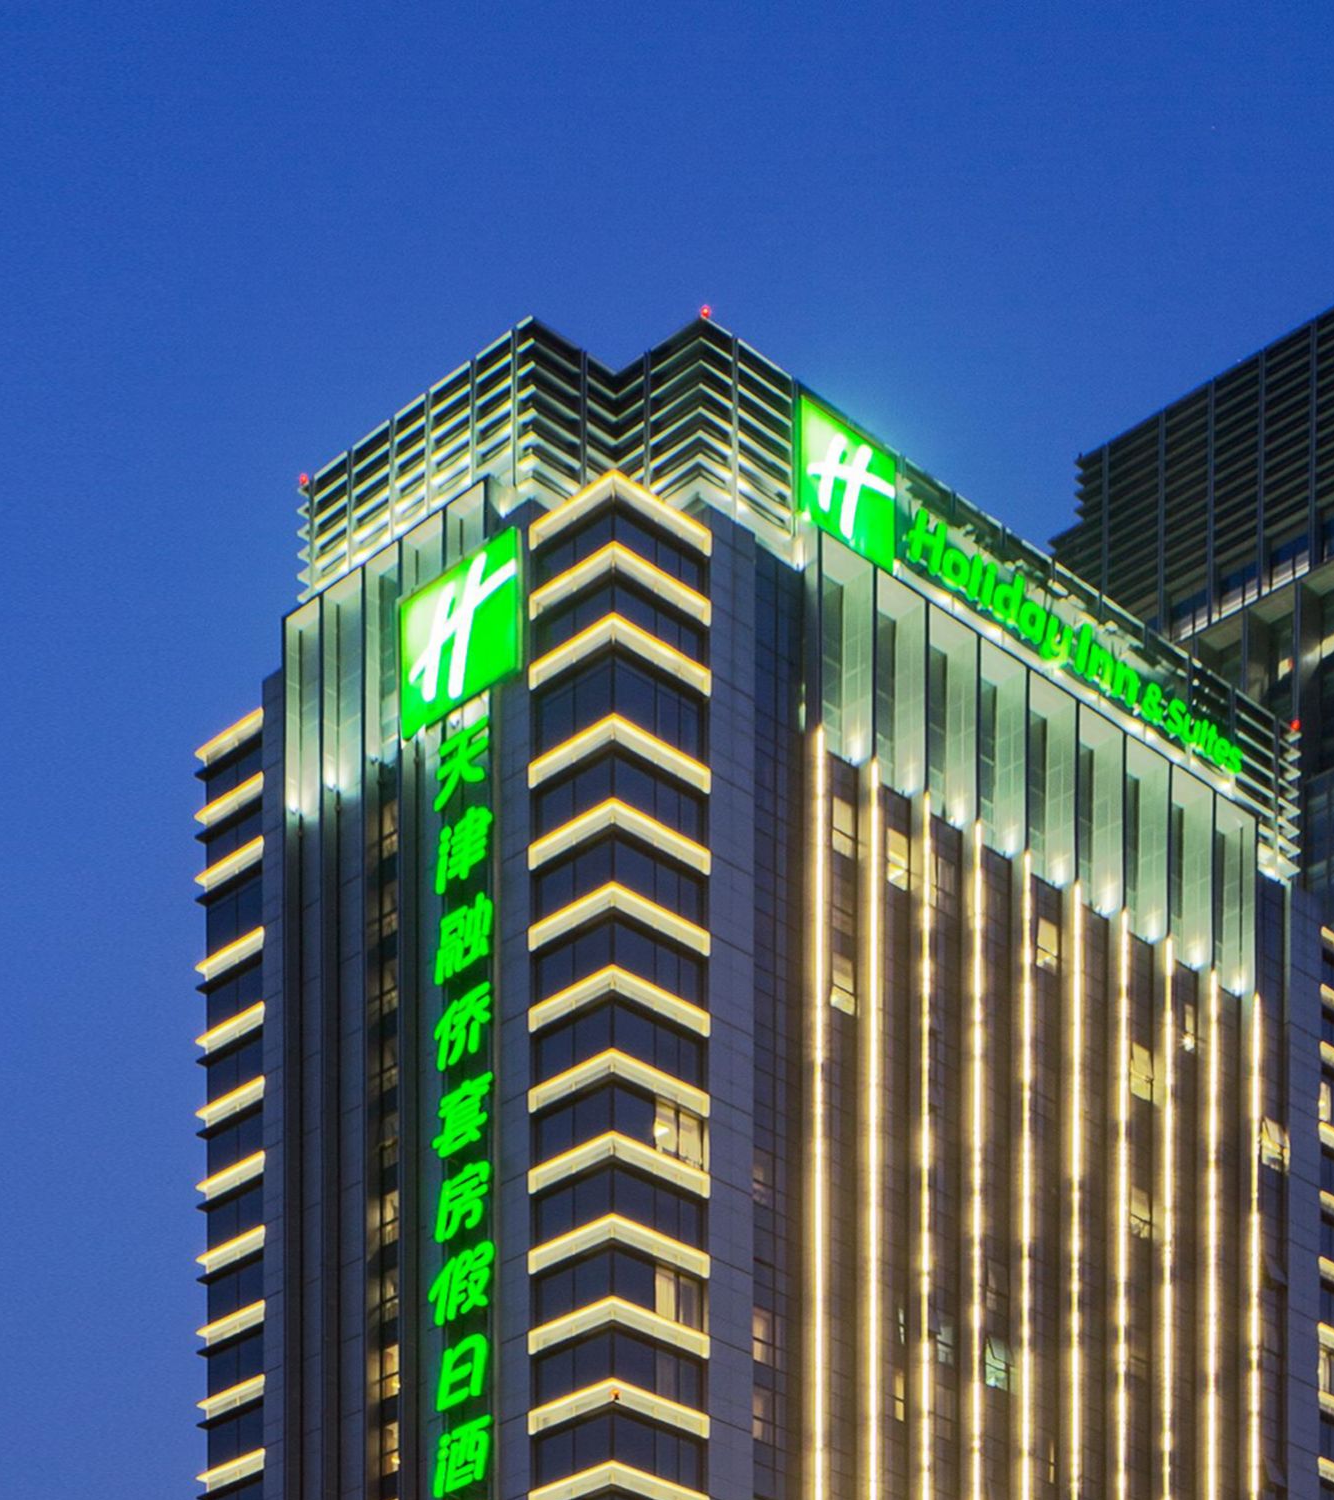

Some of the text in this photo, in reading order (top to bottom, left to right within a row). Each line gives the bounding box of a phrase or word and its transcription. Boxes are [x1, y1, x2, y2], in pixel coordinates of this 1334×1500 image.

[905, 507, 1245, 775] Holiday Inn & Suites
